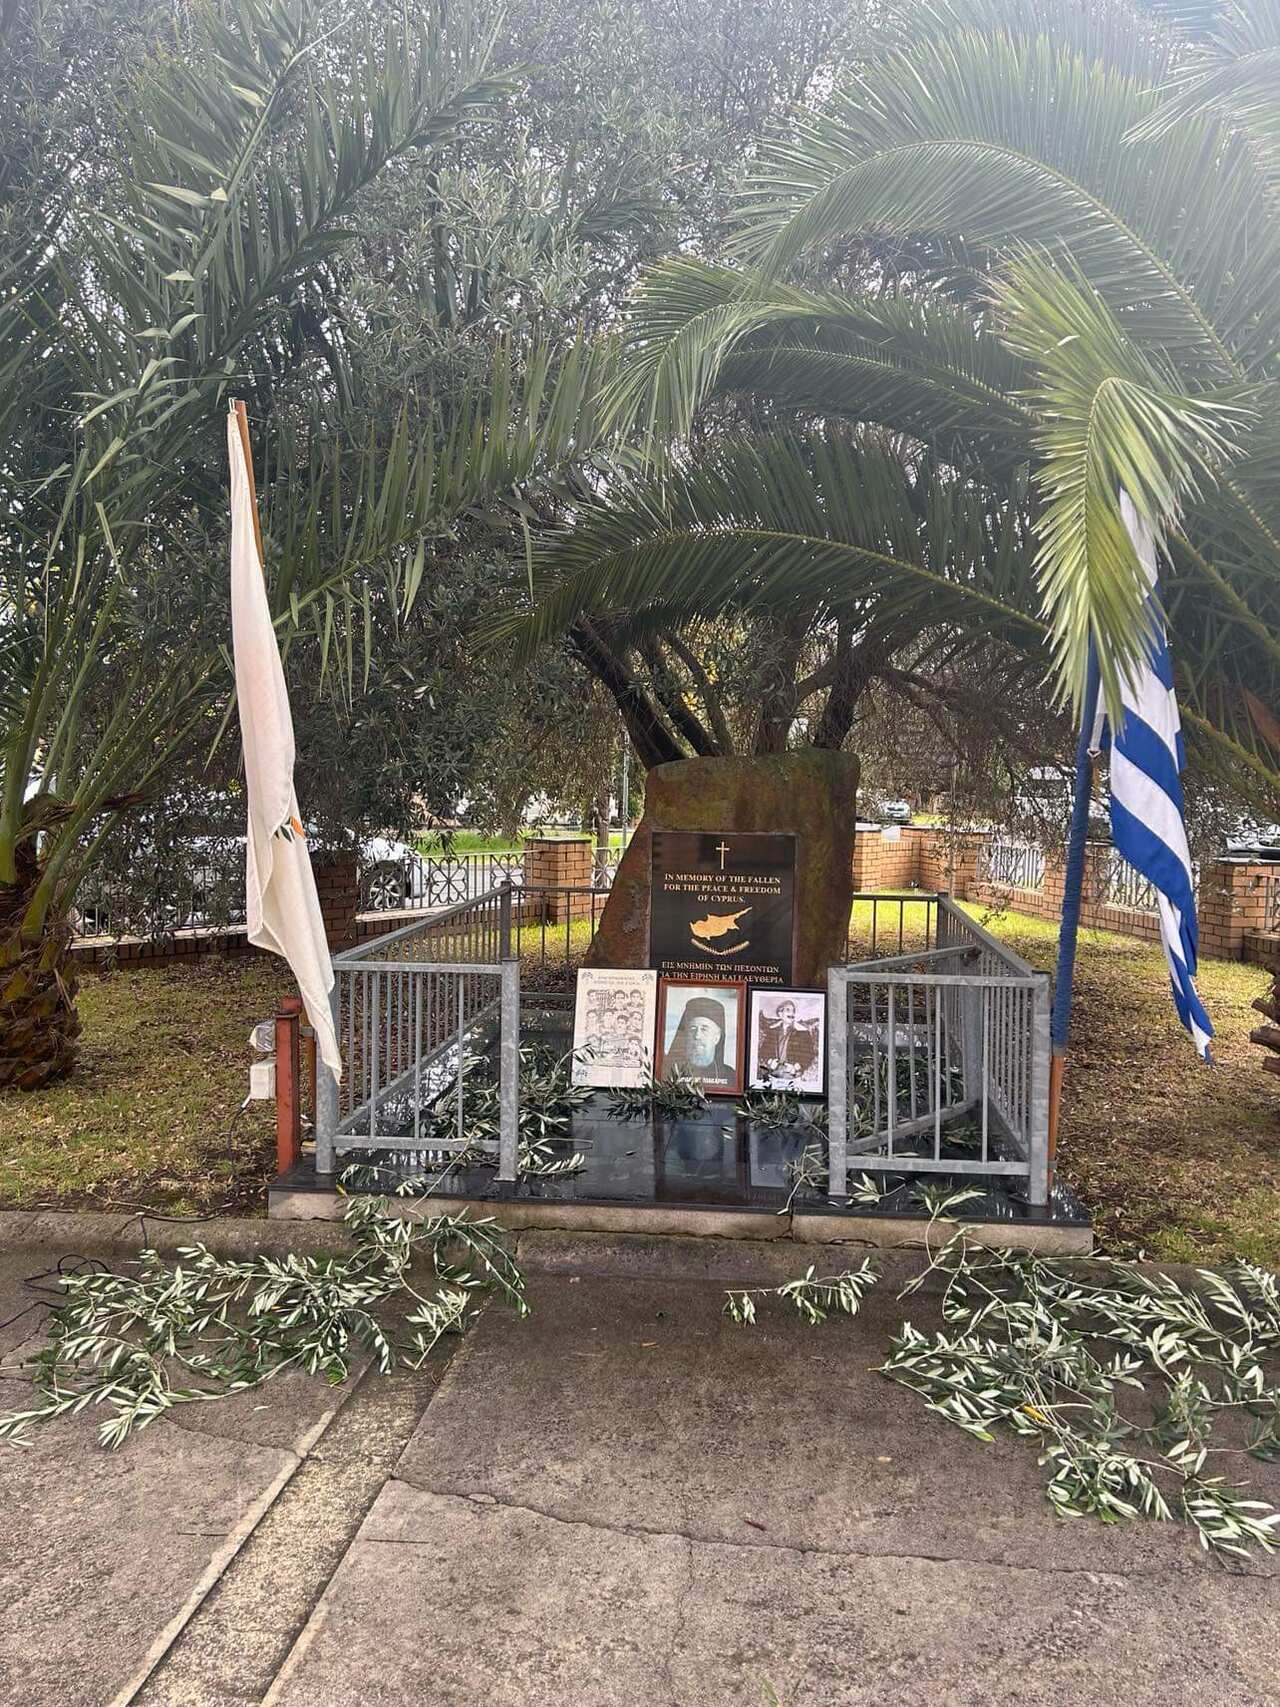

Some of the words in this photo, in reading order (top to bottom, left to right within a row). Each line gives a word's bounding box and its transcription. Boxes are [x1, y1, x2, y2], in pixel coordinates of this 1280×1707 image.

[664, 872, 674, 881] IN
[675, 873, 715, 882] MEMORY
[715, 874, 726, 883] OF
[728, 874, 746, 883] THE
[748, 875, 781, 884] FALLEN
[664, 883, 681, 892] FOR
[683, 883, 698, 892] THE
[702, 884, 729, 893] PEACE
[730, 885, 737, 893] &
[739, 886, 781, 894] FREEDOM
[697, 894, 708, 902] OF
[661, 961, 675, 969] ΕΙΣ
[676, 961, 714, 970] ΜΝΗΜΗΝ
[716, 963, 732, 971] ΤΩΝ
[734, 964, 780, 973] ΠΕΣΟΝΤΩΝ
[690, 972, 720, 981] ΕΙΡΗΝΗ
[722, 974, 737, 982] ΚΑΙ
